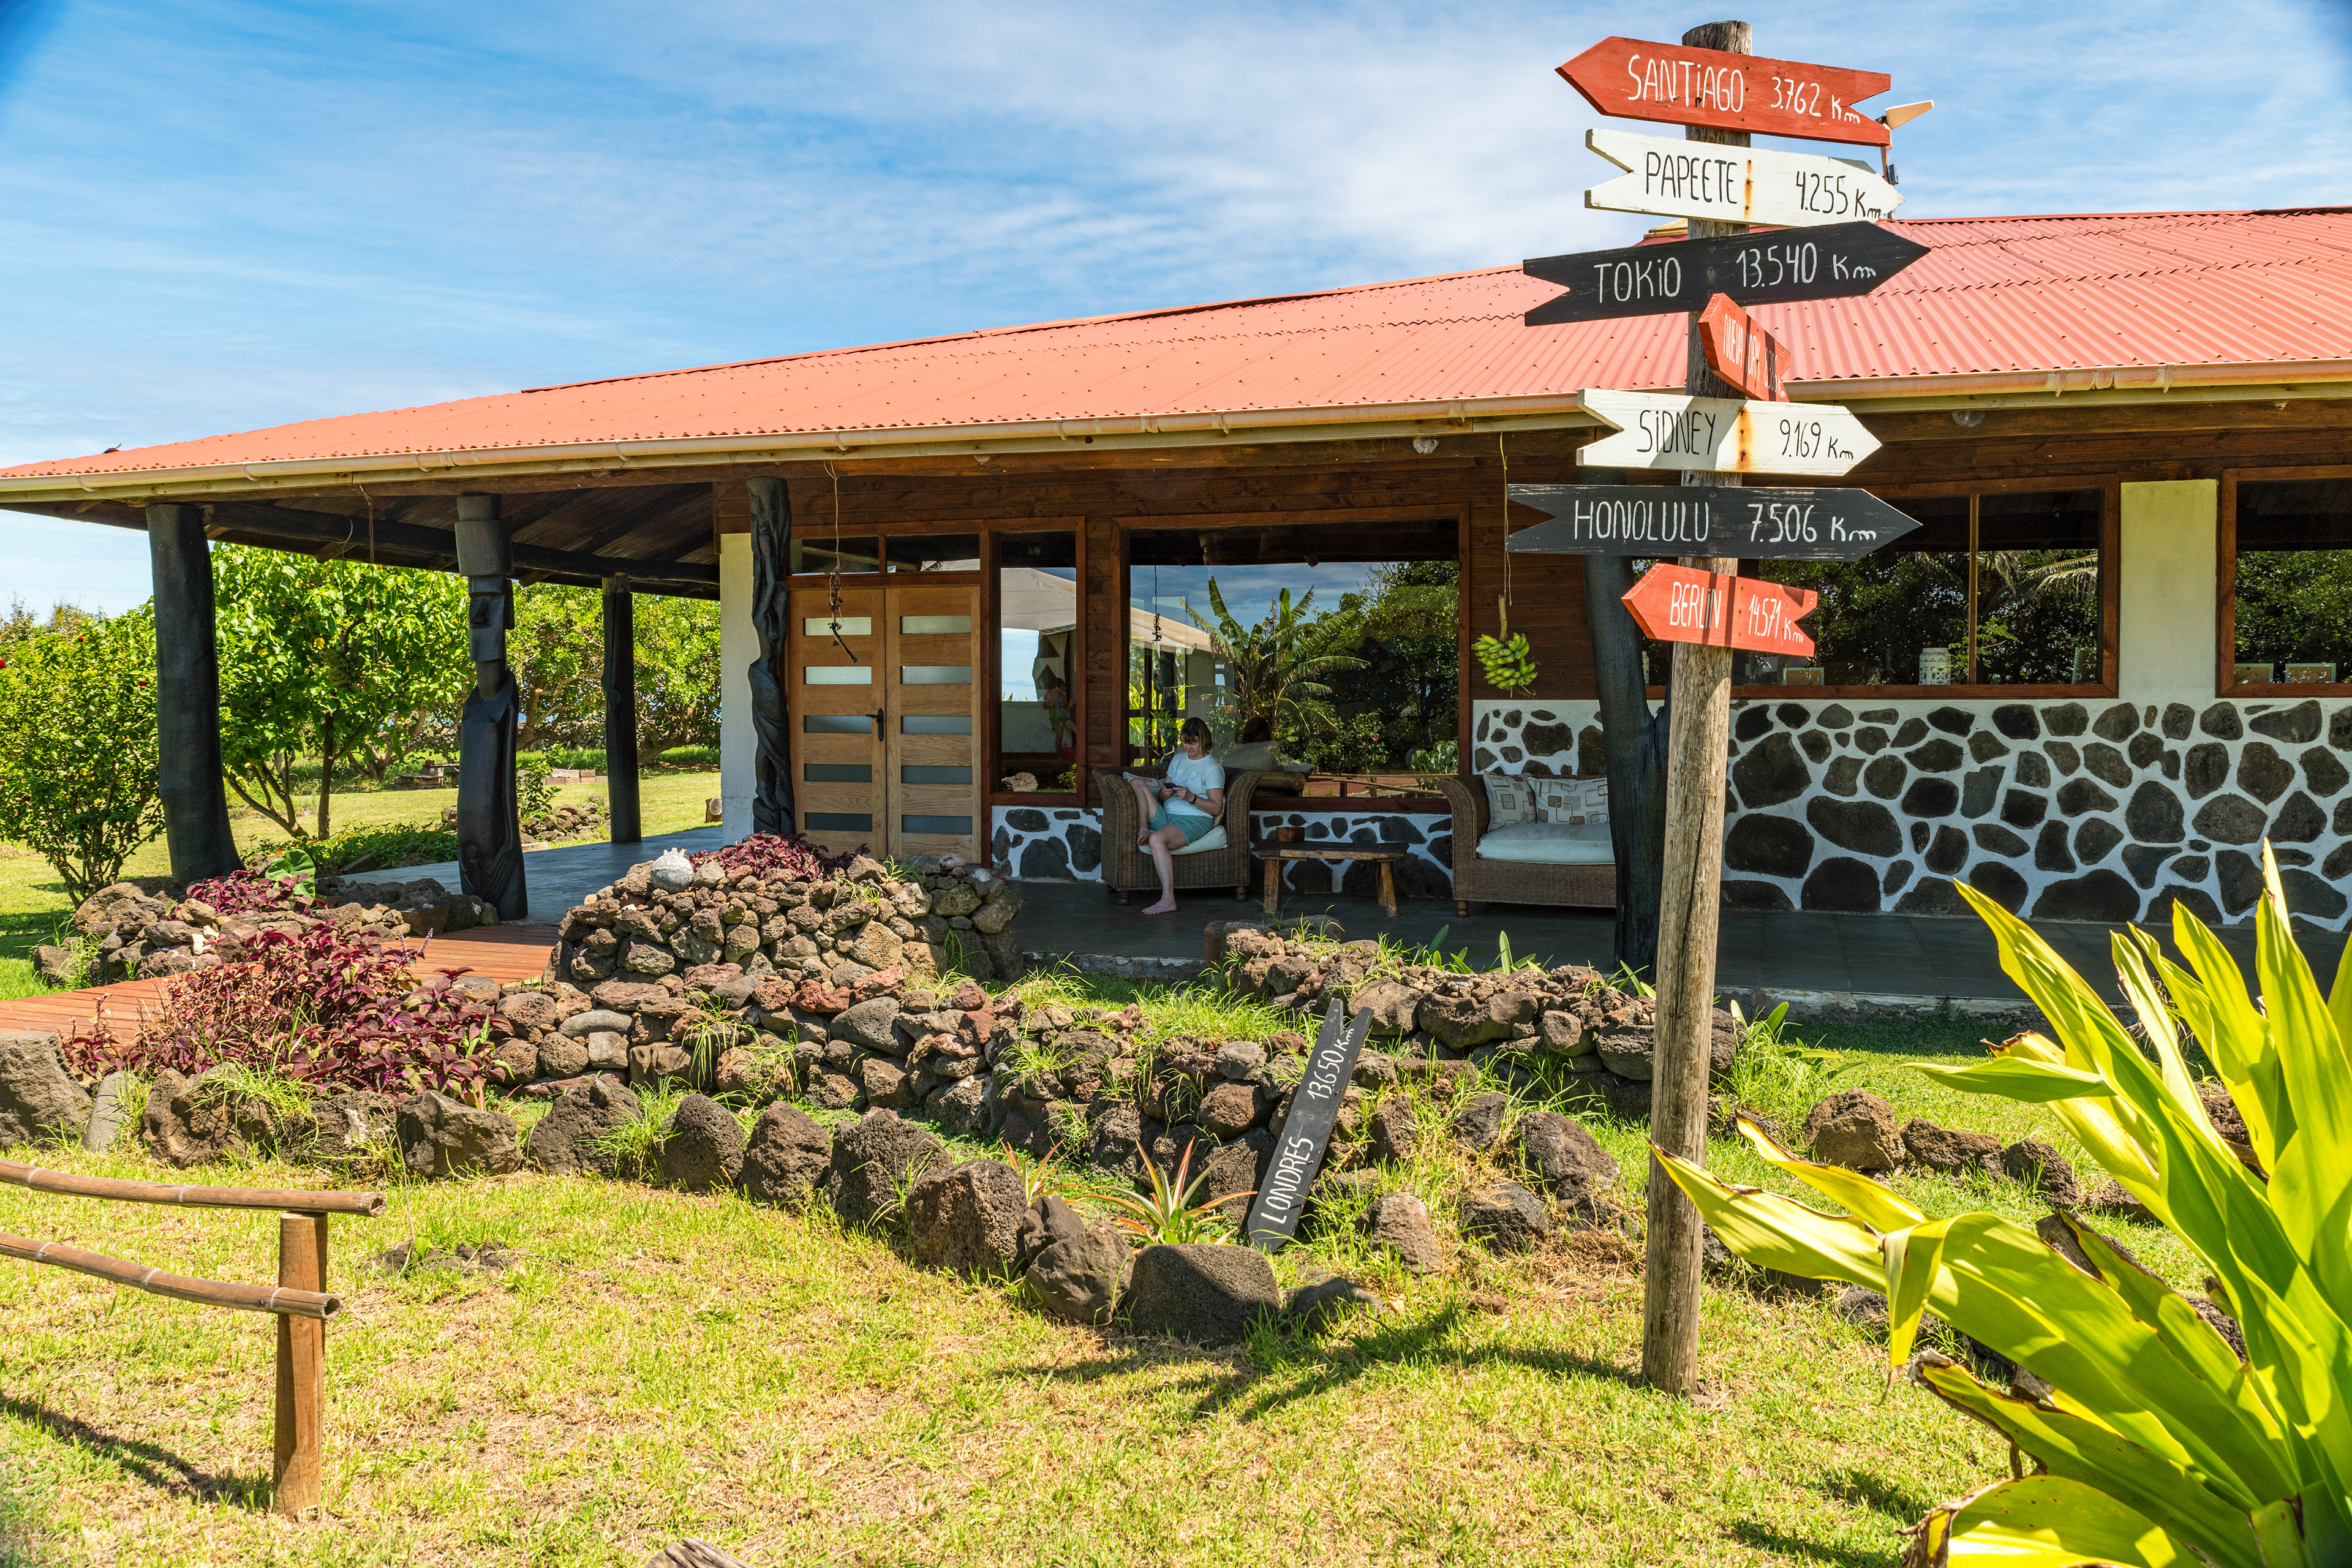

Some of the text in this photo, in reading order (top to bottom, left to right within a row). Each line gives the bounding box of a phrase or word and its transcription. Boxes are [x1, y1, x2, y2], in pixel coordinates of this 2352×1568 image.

[1770, 77, 1822, 117] 3.762
[1831, 94, 1861, 124] Km
[1646, 151, 1882, 219] PAPEETE 4.255 Km
[1736, 242, 1817, 288] 13.540
[1833, 254, 1877, 280] Km
[1723, 313, 1743, 369] NUEVA
[1745, 331, 1761, 382] YORK
[1779, 419, 1821, 458] 9.169
[1828, 436, 1854, 461] Km
[1574, 500, 1877, 543] HONOLULU 7.506 Km
[1748, 594, 1781, 639] 14.571
[1784, 617, 1804, 643] Km
[1261, 1028, 1354, 1224] LONDRES 13.650 Km
